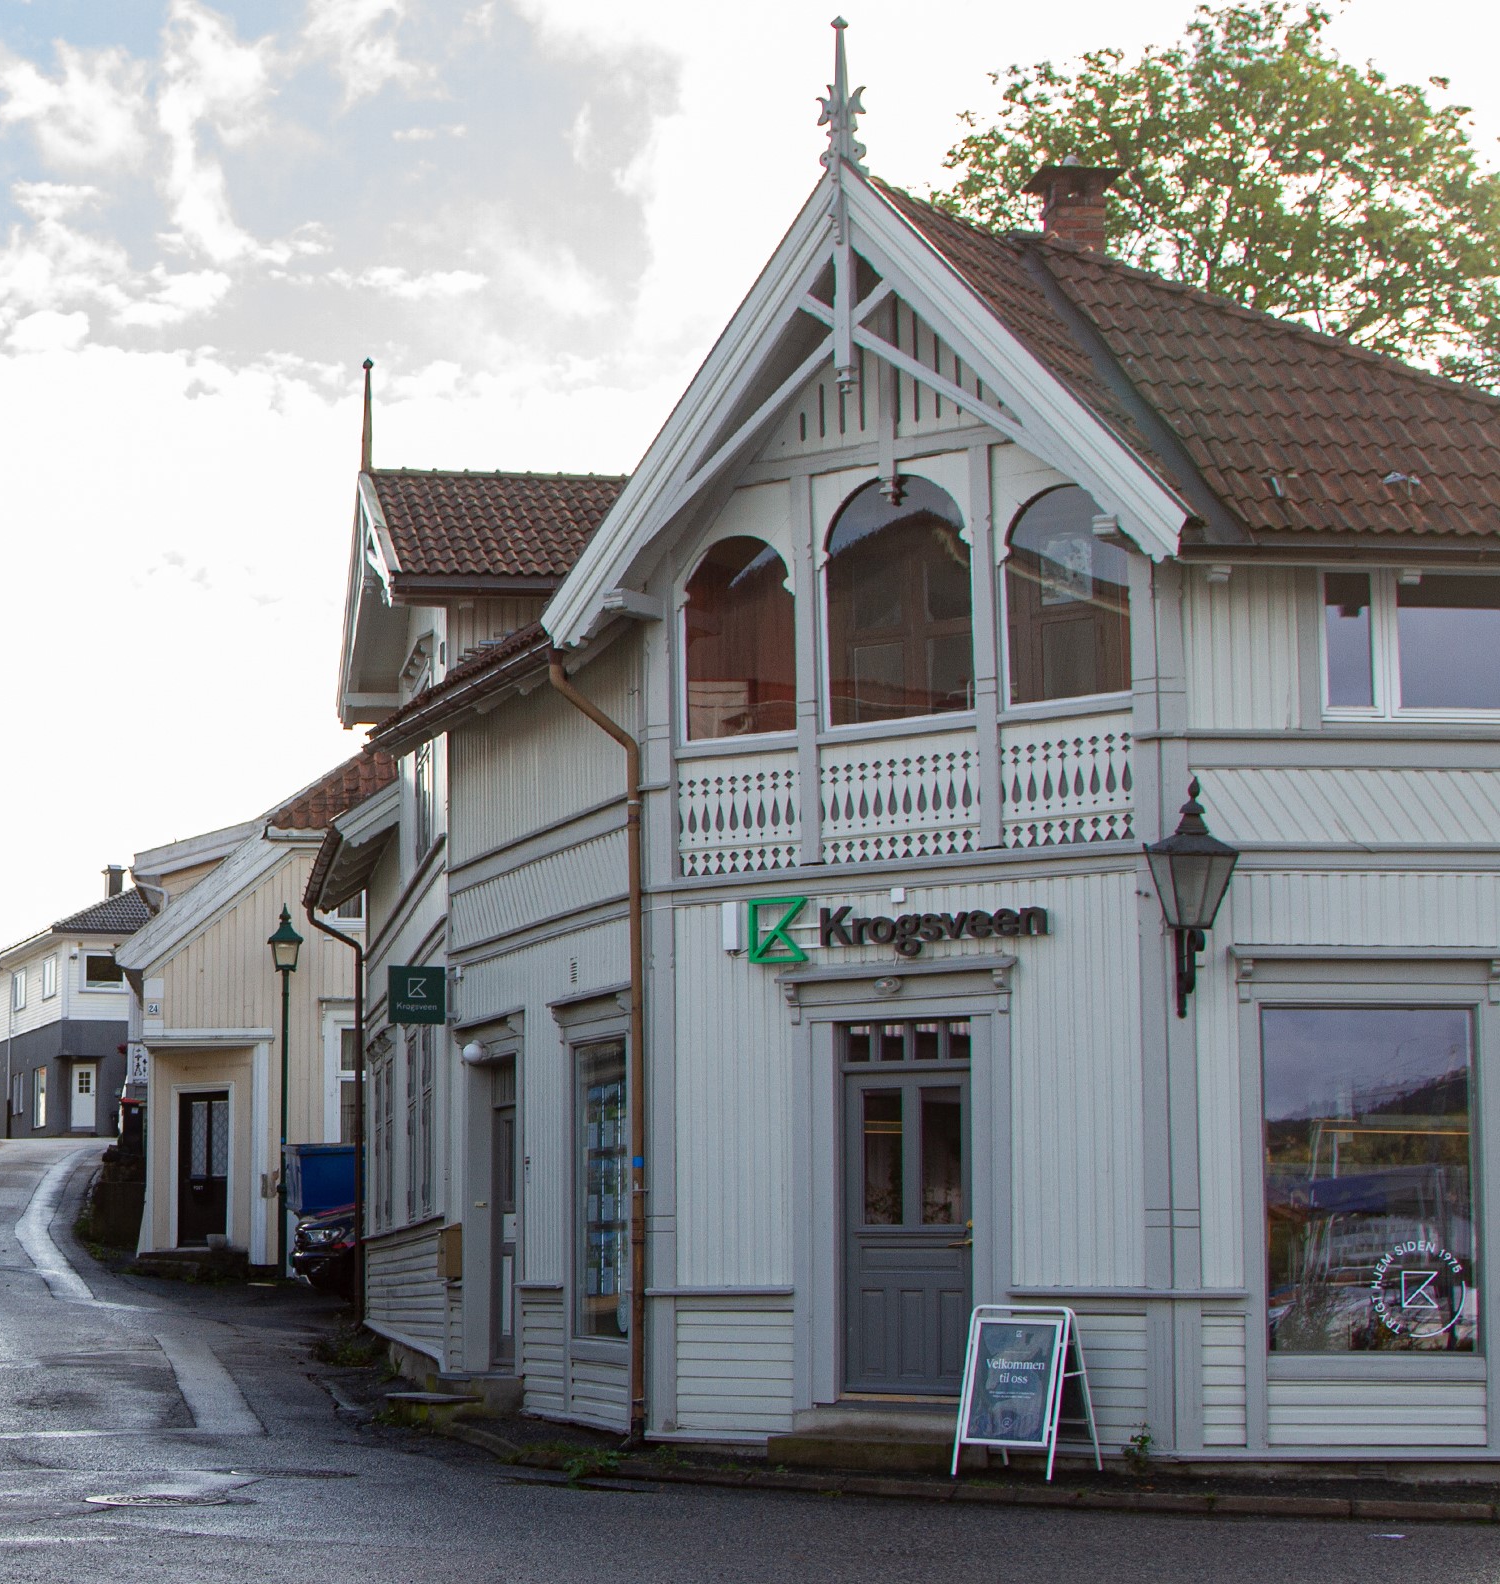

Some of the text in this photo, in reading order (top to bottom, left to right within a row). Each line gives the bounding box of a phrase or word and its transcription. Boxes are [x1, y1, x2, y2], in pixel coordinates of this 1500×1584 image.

[819, 906, 1049, 957] Krogsveen
[148, 1004, 158, 1013] 24
[396, 1001, 438, 1012] Krogsveen
[1394, 1240, 1436, 1256] SIDEN
[1370, 1252, 1395, 1290] HJEM
[1371, 1295, 1401, 1335] TRYGT
[986, 1358, 1045, 1370] Velkommen
[999, 1372, 1028, 1384] til oss
